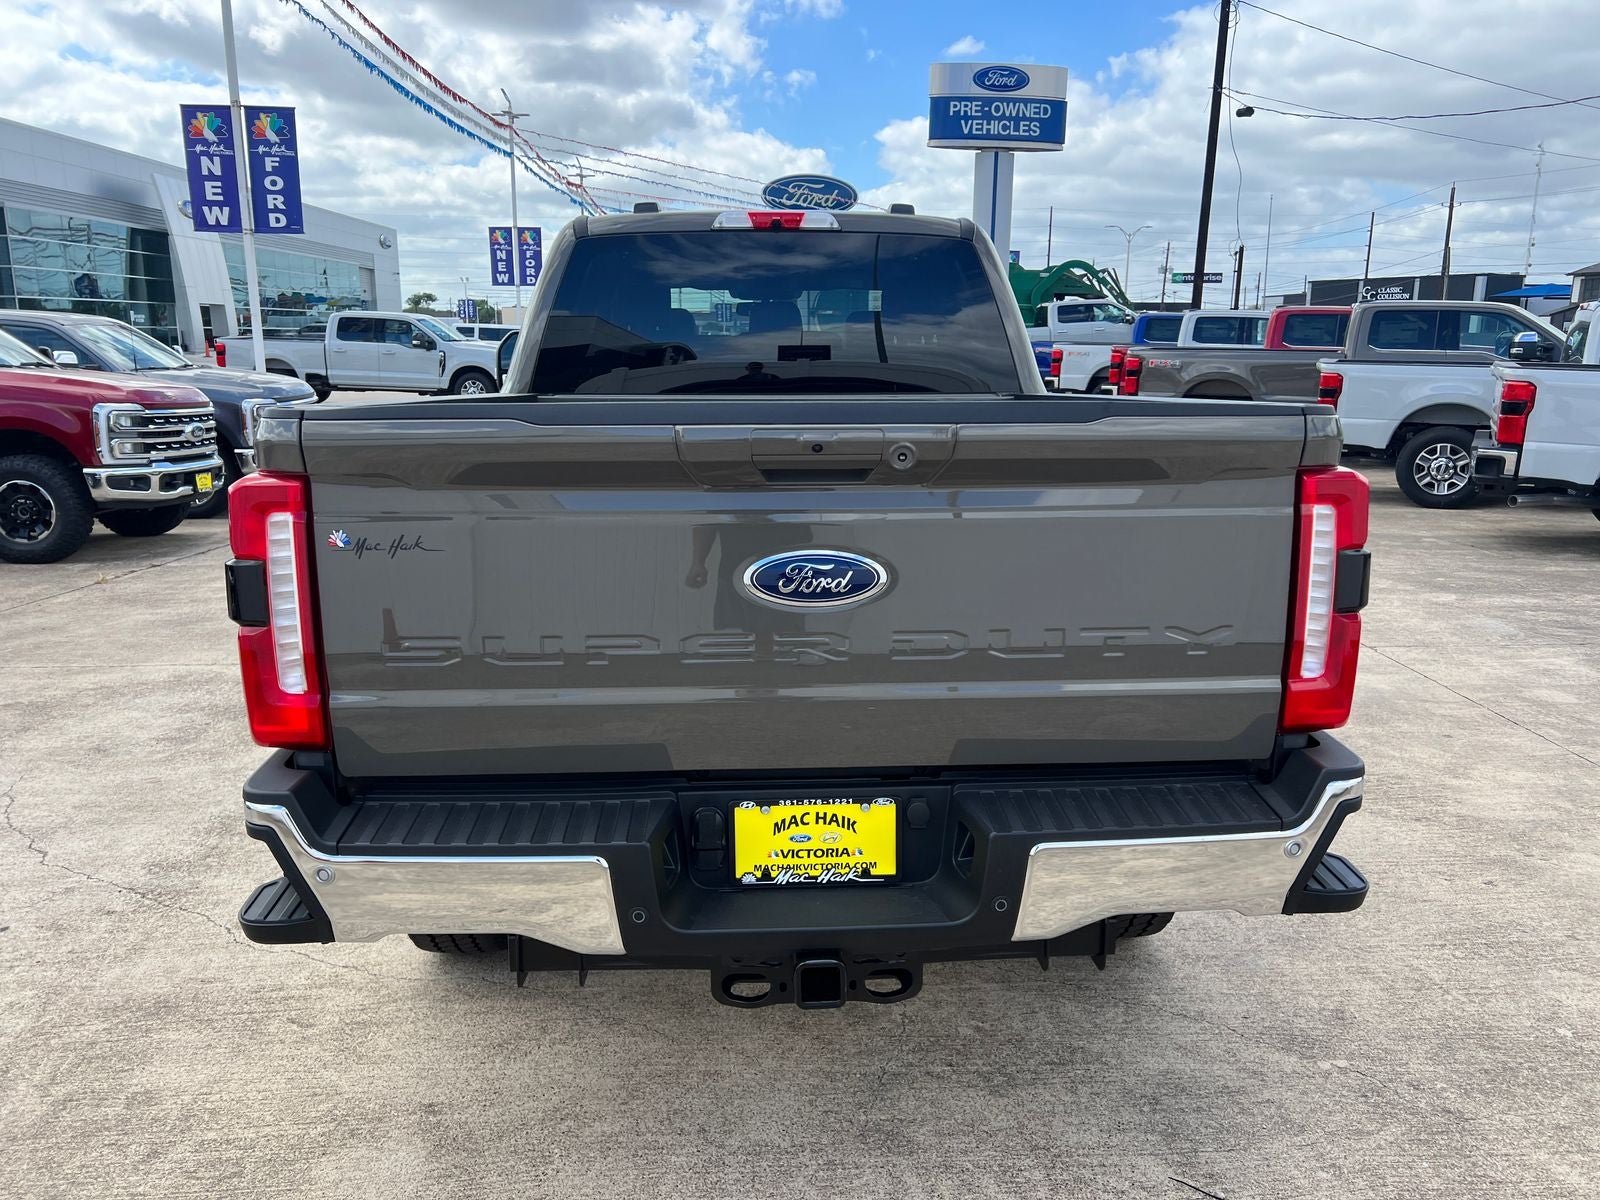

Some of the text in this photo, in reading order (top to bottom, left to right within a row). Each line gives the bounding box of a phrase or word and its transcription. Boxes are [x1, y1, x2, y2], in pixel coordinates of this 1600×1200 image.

[984, 69, 1018, 86] Ford
[961, 120, 1041, 136] VEHICLES
[200, 156, 230, 226] NEW
[263, 157, 288, 228] FORD
[783, 182, 839, 208] Ford
[495, 250, 509, 283] NEW
[525, 250, 536, 284] FORD
[350, 534, 436, 560] Mac Haik
[778, 563, 853, 594] Ford
[381, 625, 1235, 666] SUPER DUTY
[778, 798, 853, 806] 361-576-1221
[773, 812, 857, 836] MAC HAIK
[780, 847, 850, 859] VICTORIA
[753, 861, 877, 872] MACHAIKVICTORIACOM
[774, 866, 864, 885] Mac Haik
